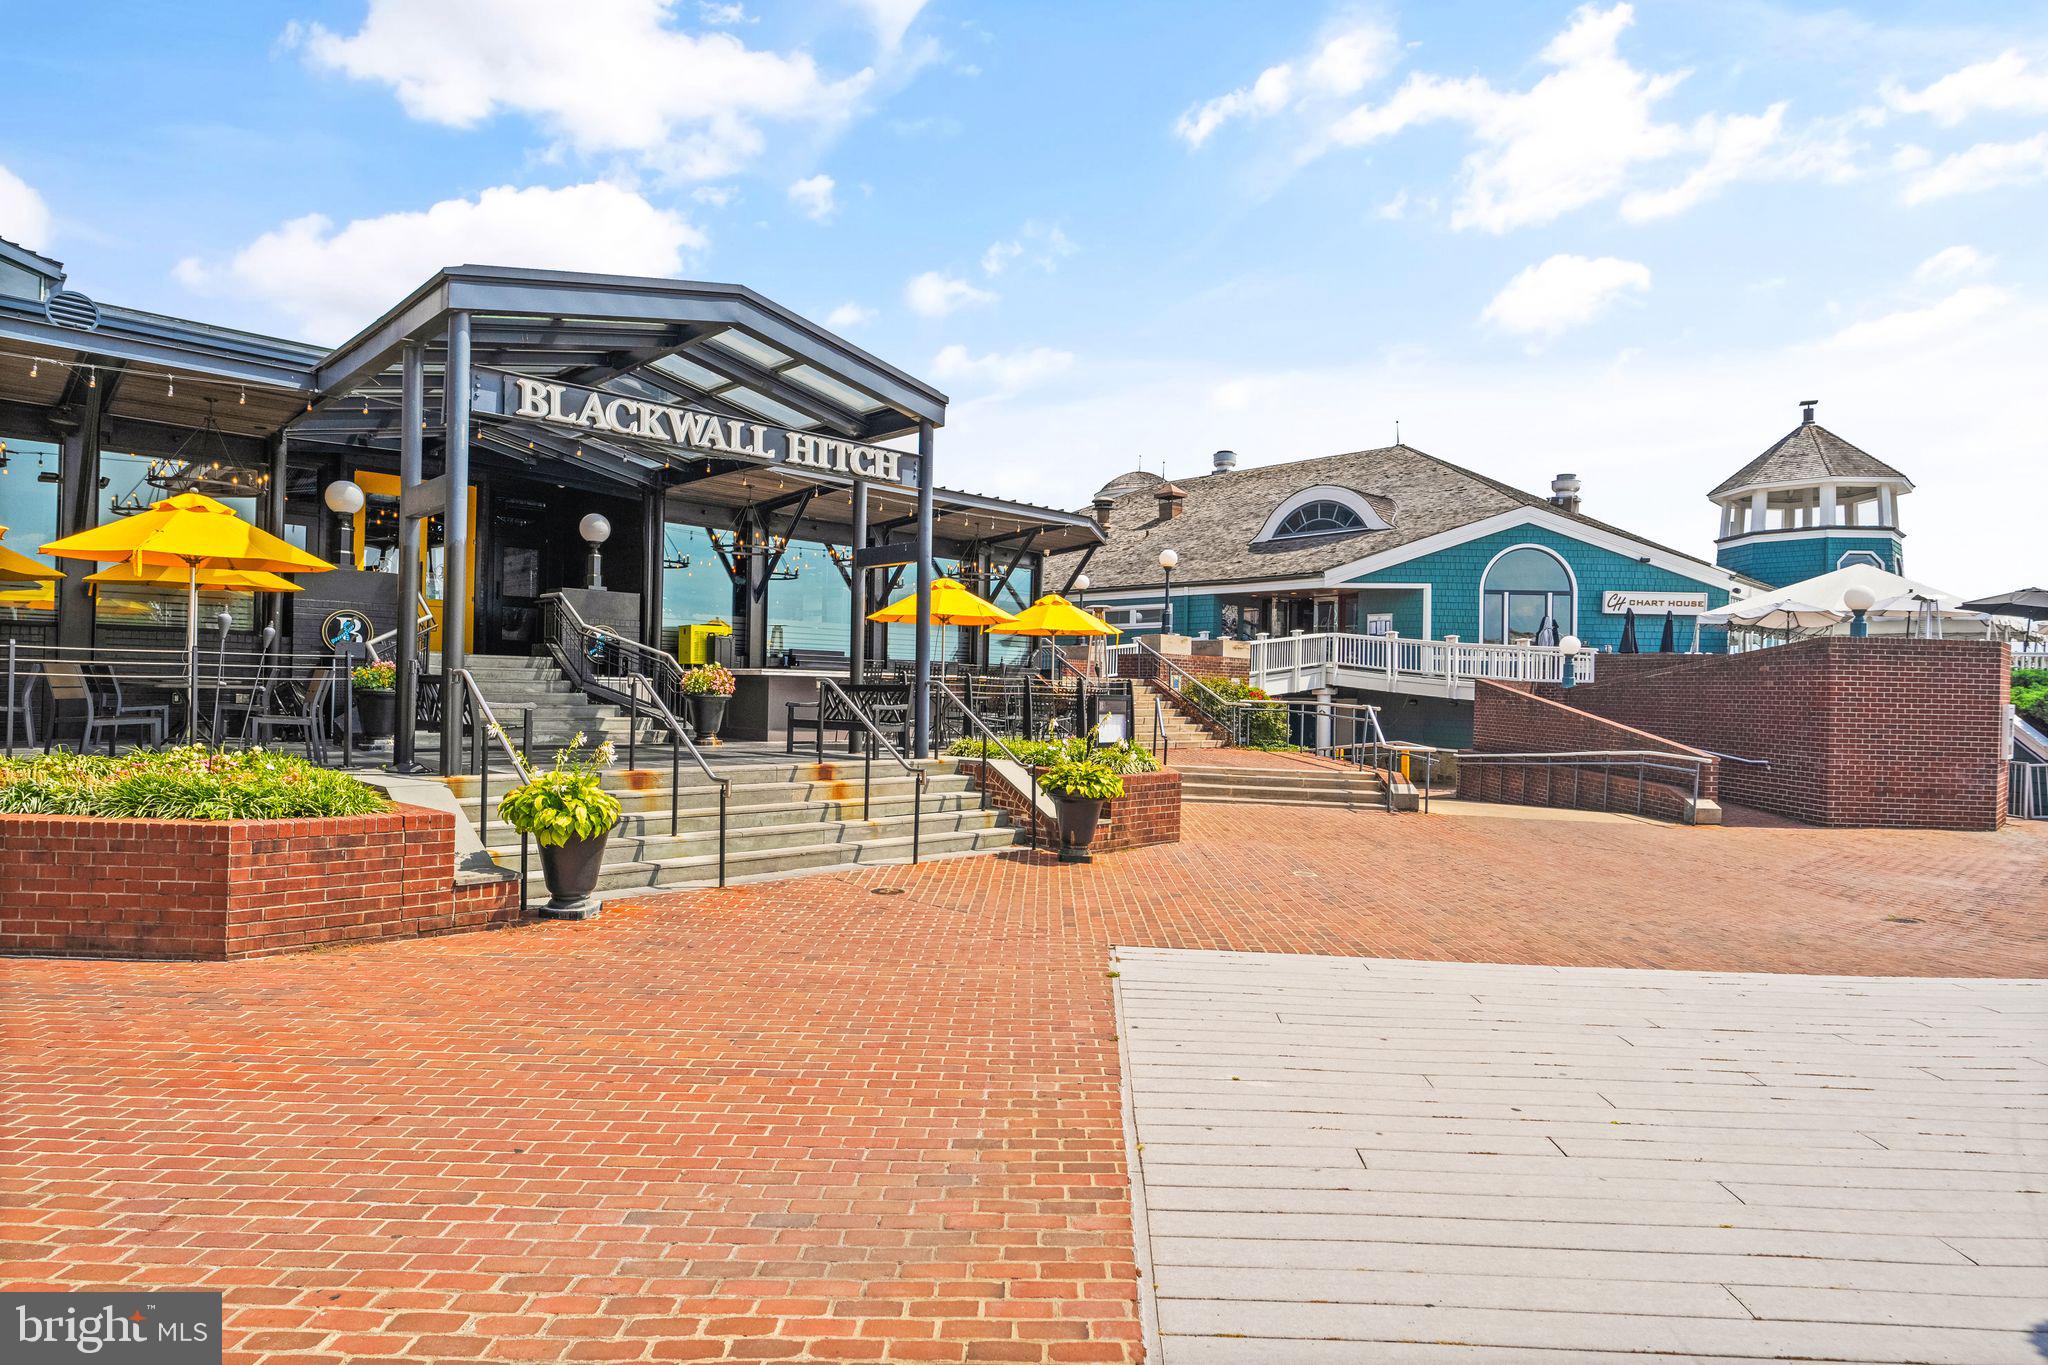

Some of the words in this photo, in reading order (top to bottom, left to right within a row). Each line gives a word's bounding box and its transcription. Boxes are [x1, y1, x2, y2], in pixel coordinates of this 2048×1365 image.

[516, 377, 776, 459] BLACKWALL
[785, 431, 902, 481] HITCH
[1629, 599, 1665, 607] CHART
[1668, 600, 1704, 608] HOUSE
